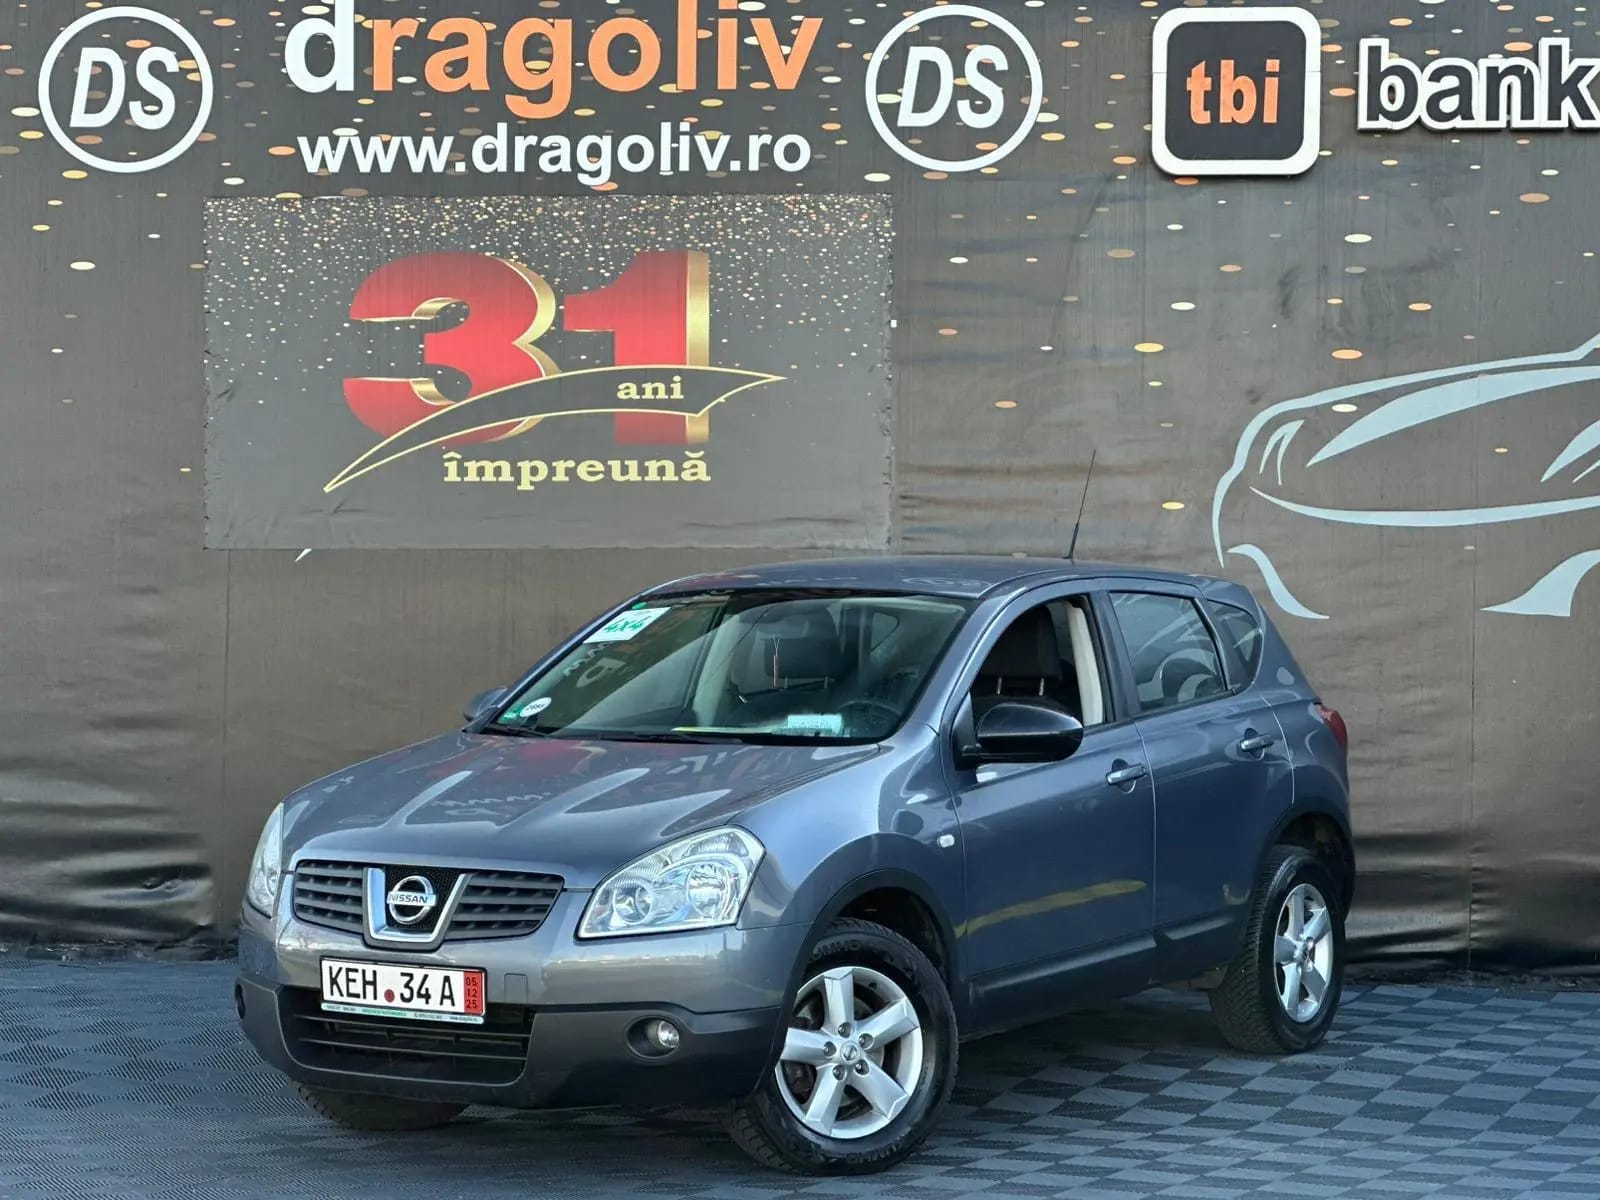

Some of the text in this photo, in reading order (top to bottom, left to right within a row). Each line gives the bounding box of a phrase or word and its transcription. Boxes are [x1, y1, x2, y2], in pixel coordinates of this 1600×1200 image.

[284, 0, 822, 119] dragoliv
[1186, 38, 1600, 130] tbi bank
[69, 46, 181, 130] DS
[897, 45, 1010, 129] DS
[297, 122, 812, 185] www.dragoliv.ro
[342, 250, 710, 445] 31
[616, 376, 684, 400] ani
[442, 451, 711, 490] împreună
[388, 894, 428, 904] NISSAN
[328, 965, 378, 1001] KEH
[466, 988, 478, 998] 12
[466, 999, 478, 1009] 25
